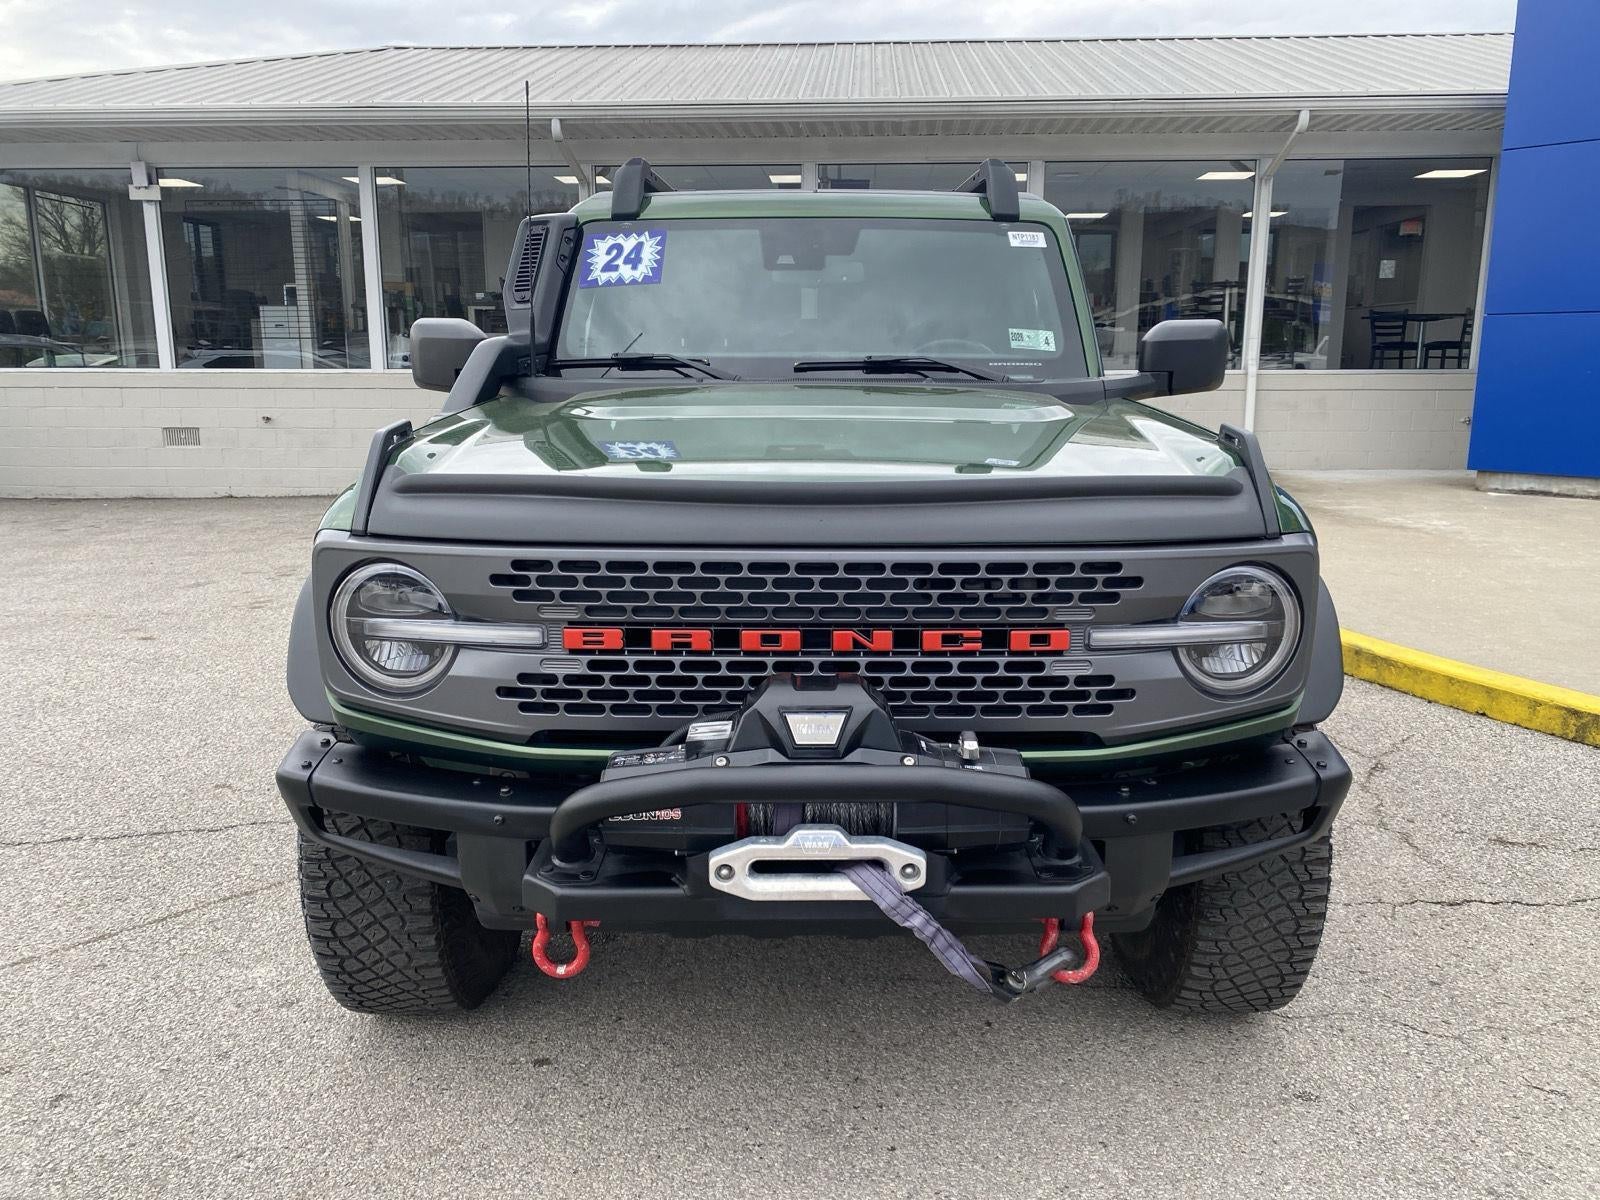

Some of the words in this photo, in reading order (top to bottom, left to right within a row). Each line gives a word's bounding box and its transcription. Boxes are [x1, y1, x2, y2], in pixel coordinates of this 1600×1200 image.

[600, 241, 645, 273] 24
[562, 627, 1071, 651] BRONCO
[804, 841, 830, 849] WARN
